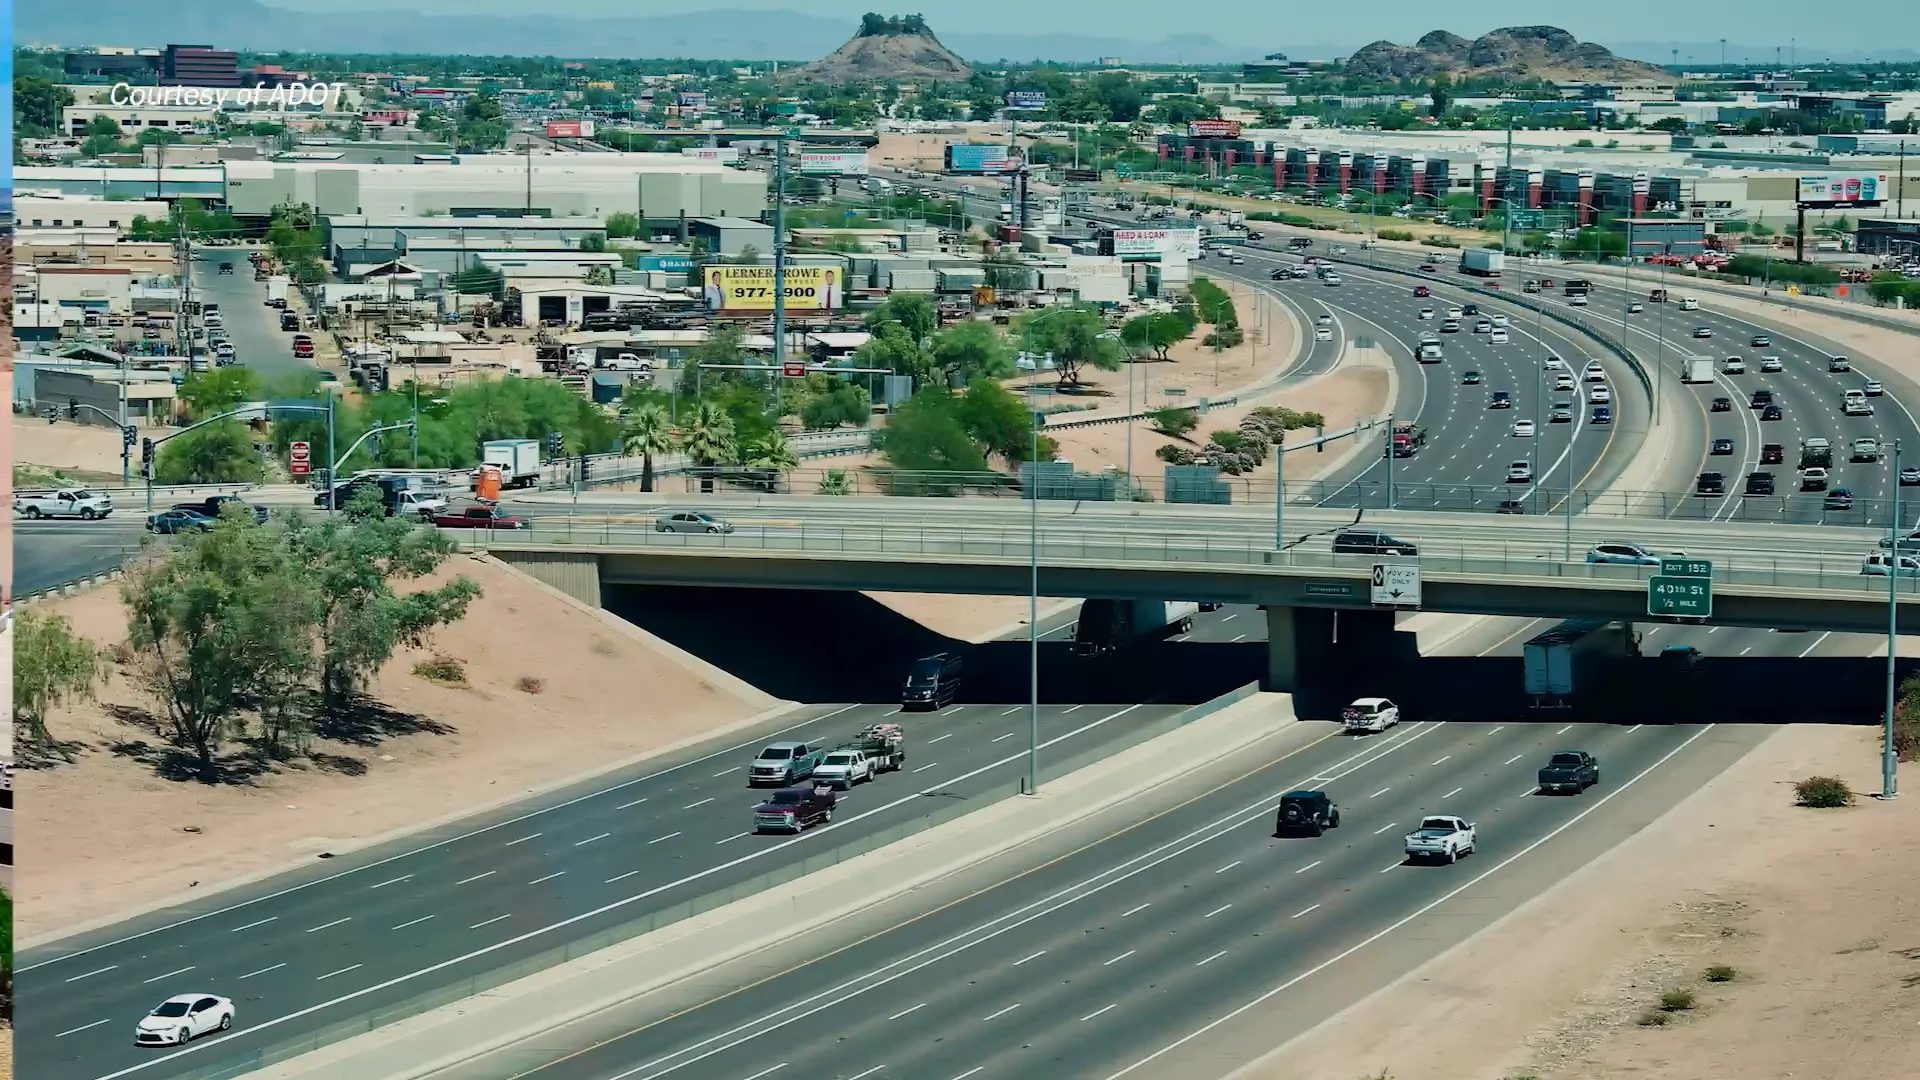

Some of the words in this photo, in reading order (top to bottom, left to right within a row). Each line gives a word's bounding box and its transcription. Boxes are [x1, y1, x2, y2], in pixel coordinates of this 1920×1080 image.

[725, 268, 775, 279] LERNER
[783, 267, 820, 278] ROWE
[735, 287, 816, 298] 977-900
[1664, 563, 1682, 571] EXIT
[1688, 563, 1707, 573] 152
[1656, 584, 1686, 594] 40th
[1690, 585, 1704, 595] St
